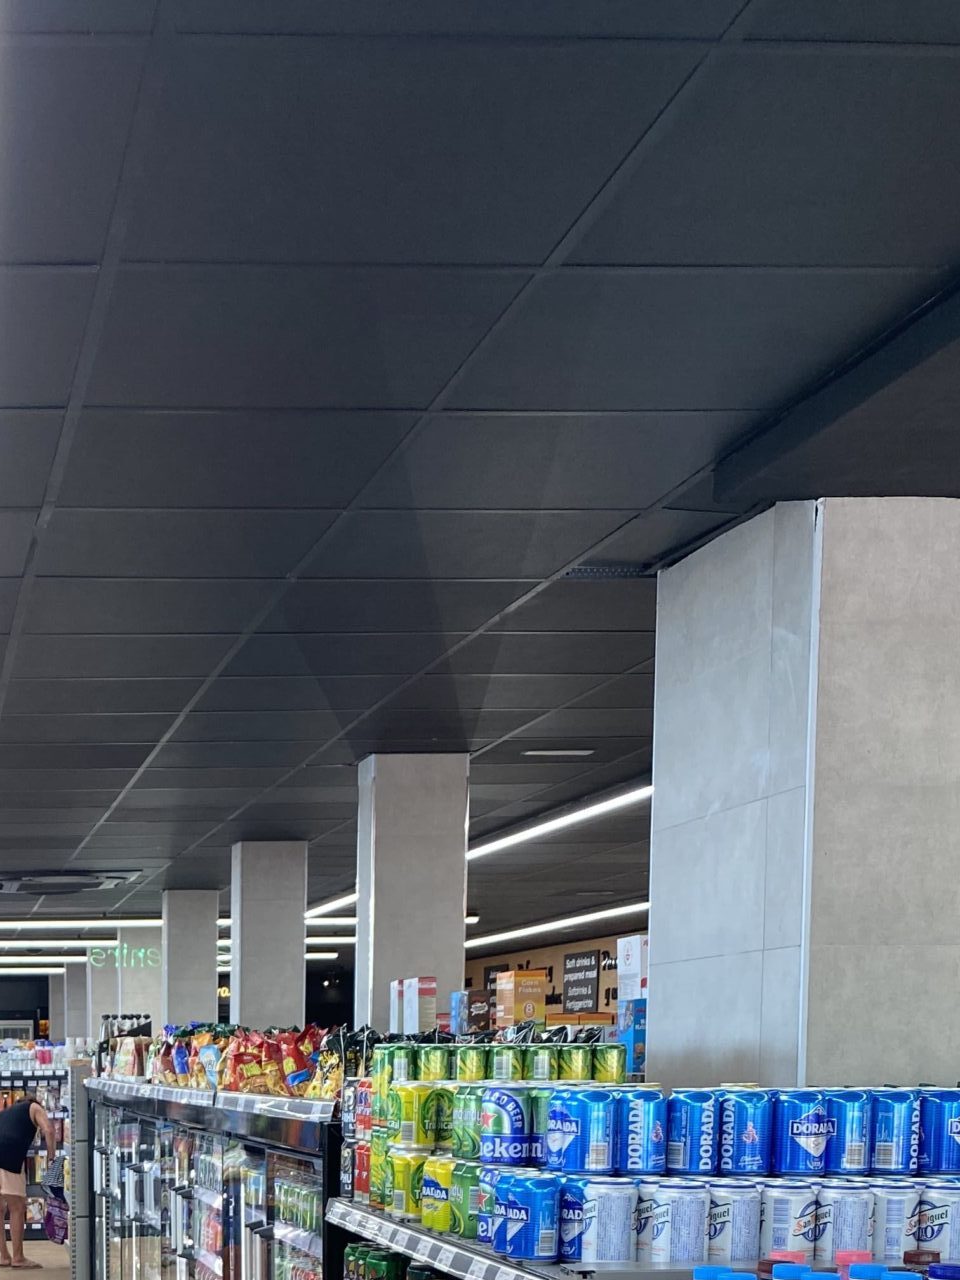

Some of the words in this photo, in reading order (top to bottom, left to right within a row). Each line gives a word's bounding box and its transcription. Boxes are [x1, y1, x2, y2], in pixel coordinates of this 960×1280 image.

[506, 1102, 523, 1128] BEER
[628, 1098, 644, 1169] DORADA
[699, 1100, 715, 1170] DORADA
[721, 1100, 735, 1169] DORADA
